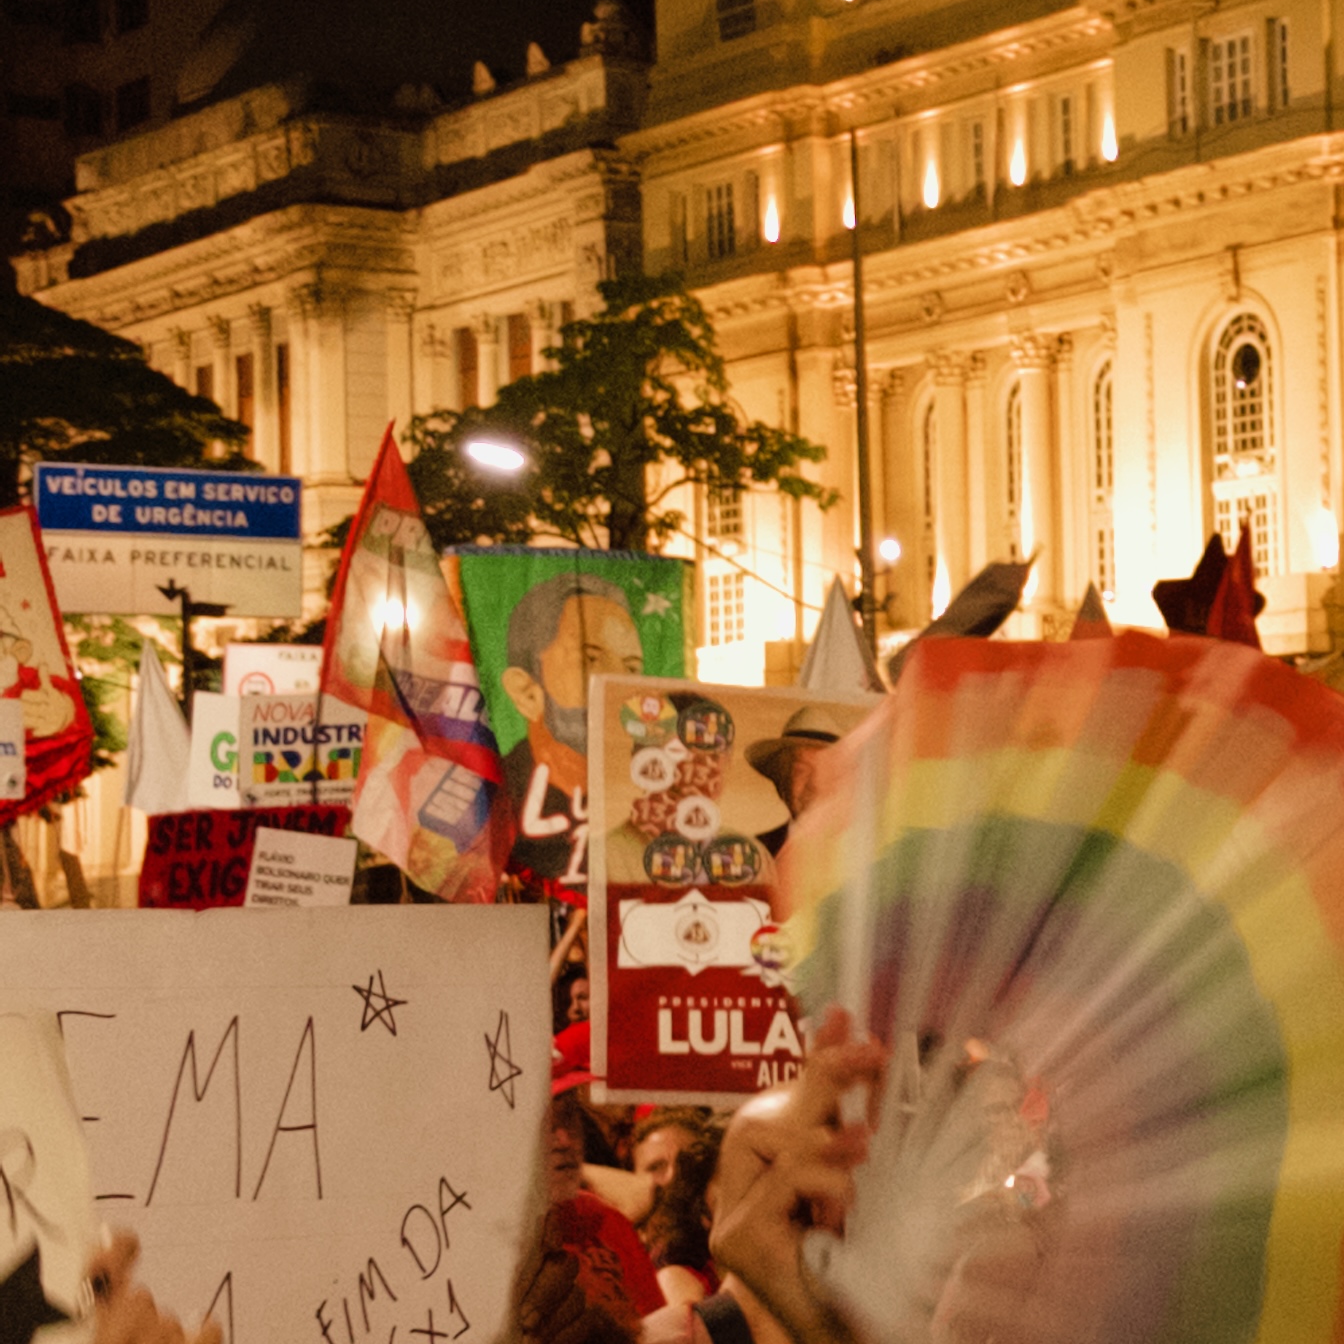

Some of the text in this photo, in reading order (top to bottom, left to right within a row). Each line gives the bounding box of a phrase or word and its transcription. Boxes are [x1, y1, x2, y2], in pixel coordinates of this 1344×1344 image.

[46, 469, 158, 499] VEÍCULOS
[164, 480, 196, 500] EM
[92, 503, 249, 528] DE URGÊNCIA
[47, 546, 293, 571] FAIXA PREFERENCIAL
[253, 702, 316, 722] NOVA
[213, 775, 232, 789] DO
[151, 812, 214, 855] SER
[256, 865, 321, 883] BOLSONARO
[287, 883, 314, 895] SEUS
[659, 996, 787, 1010] PRESIDENTE
[658, 1009, 804, 1056] LULA
[400, 1175, 473, 1281] DA
